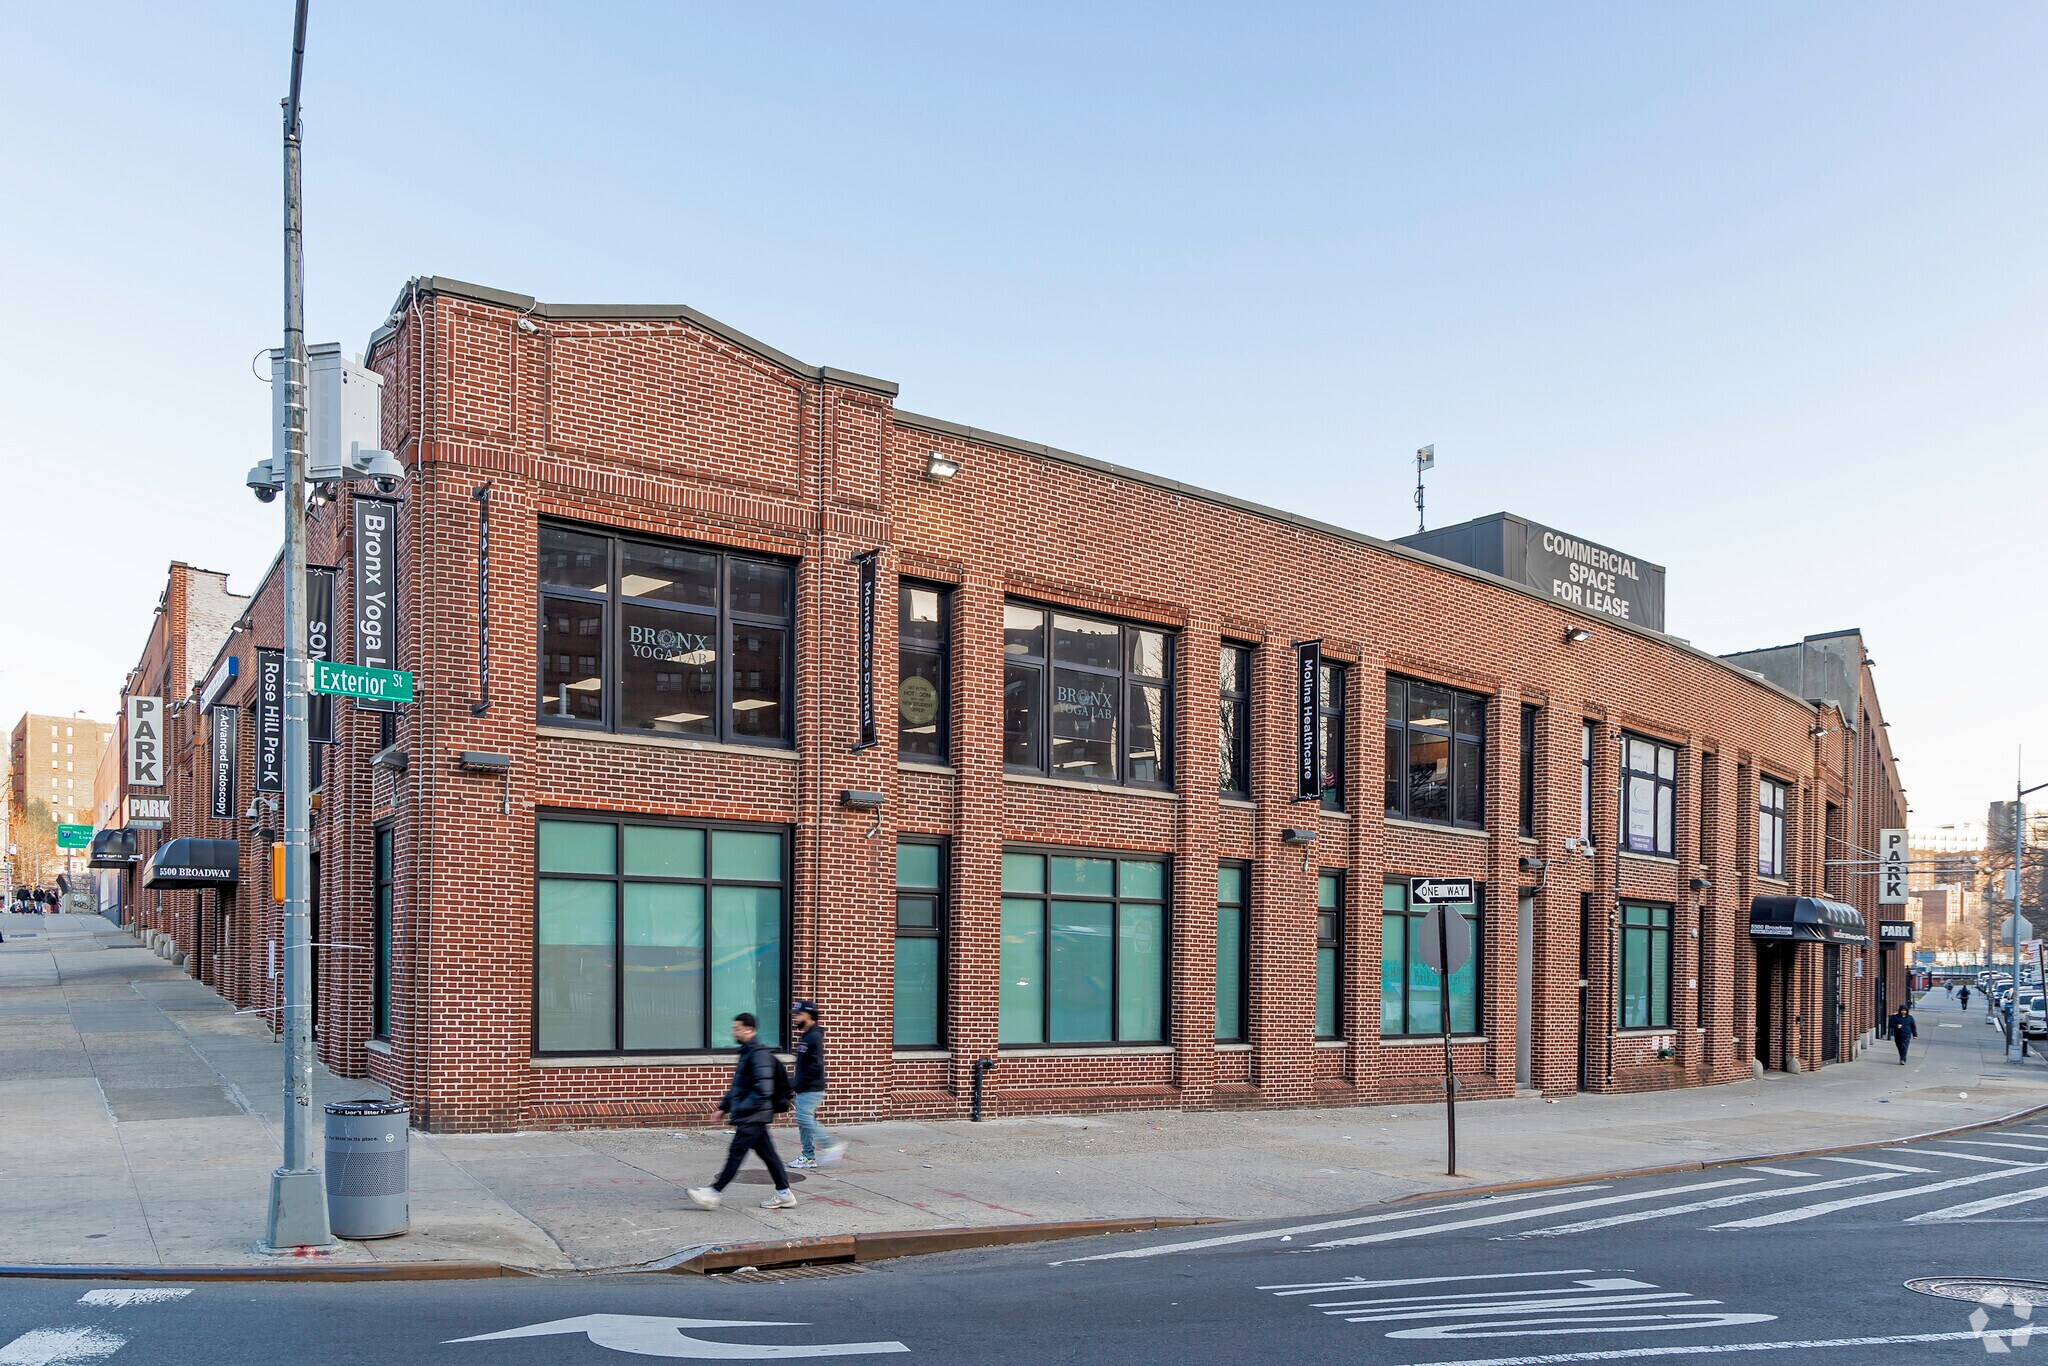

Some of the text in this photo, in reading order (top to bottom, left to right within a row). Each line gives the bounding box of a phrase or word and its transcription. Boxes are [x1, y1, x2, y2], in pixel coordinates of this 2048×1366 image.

[364, 515, 386, 585] Bronx
[481, 522, 488, 551] 24
[1543, 532, 1639, 580] COMMERCIAL
[1569, 562, 1616, 594] SPACE
[1553, 579, 1629, 619] FOR LEASE
[360, 591, 386, 650] Yoga
[629, 626, 708, 651] BRONX
[631, 644, 707, 665] YOGA LAB
[320, 666, 386, 695] Exterior
[393, 673, 403, 688] St
[1057, 686, 1112, 708] BRONX
[1058, 702, 1112, 719] YOGA LAB
[264, 662, 280, 783] Rose Hill Pre-K
[1304, 660, 1313, 779] Molina Healthcare
[134, 699, 157, 781] PARK
[216, 714, 230, 815] Advanced Endoscopy
[130, 799, 170, 817] PARK
[159, 867, 231, 878] 5500 BROADWAY
[1887, 835, 1901, 896] PARK
[1422, 886, 1465, 896] ONE WAY
[1881, 926, 1910, 937] PARK
